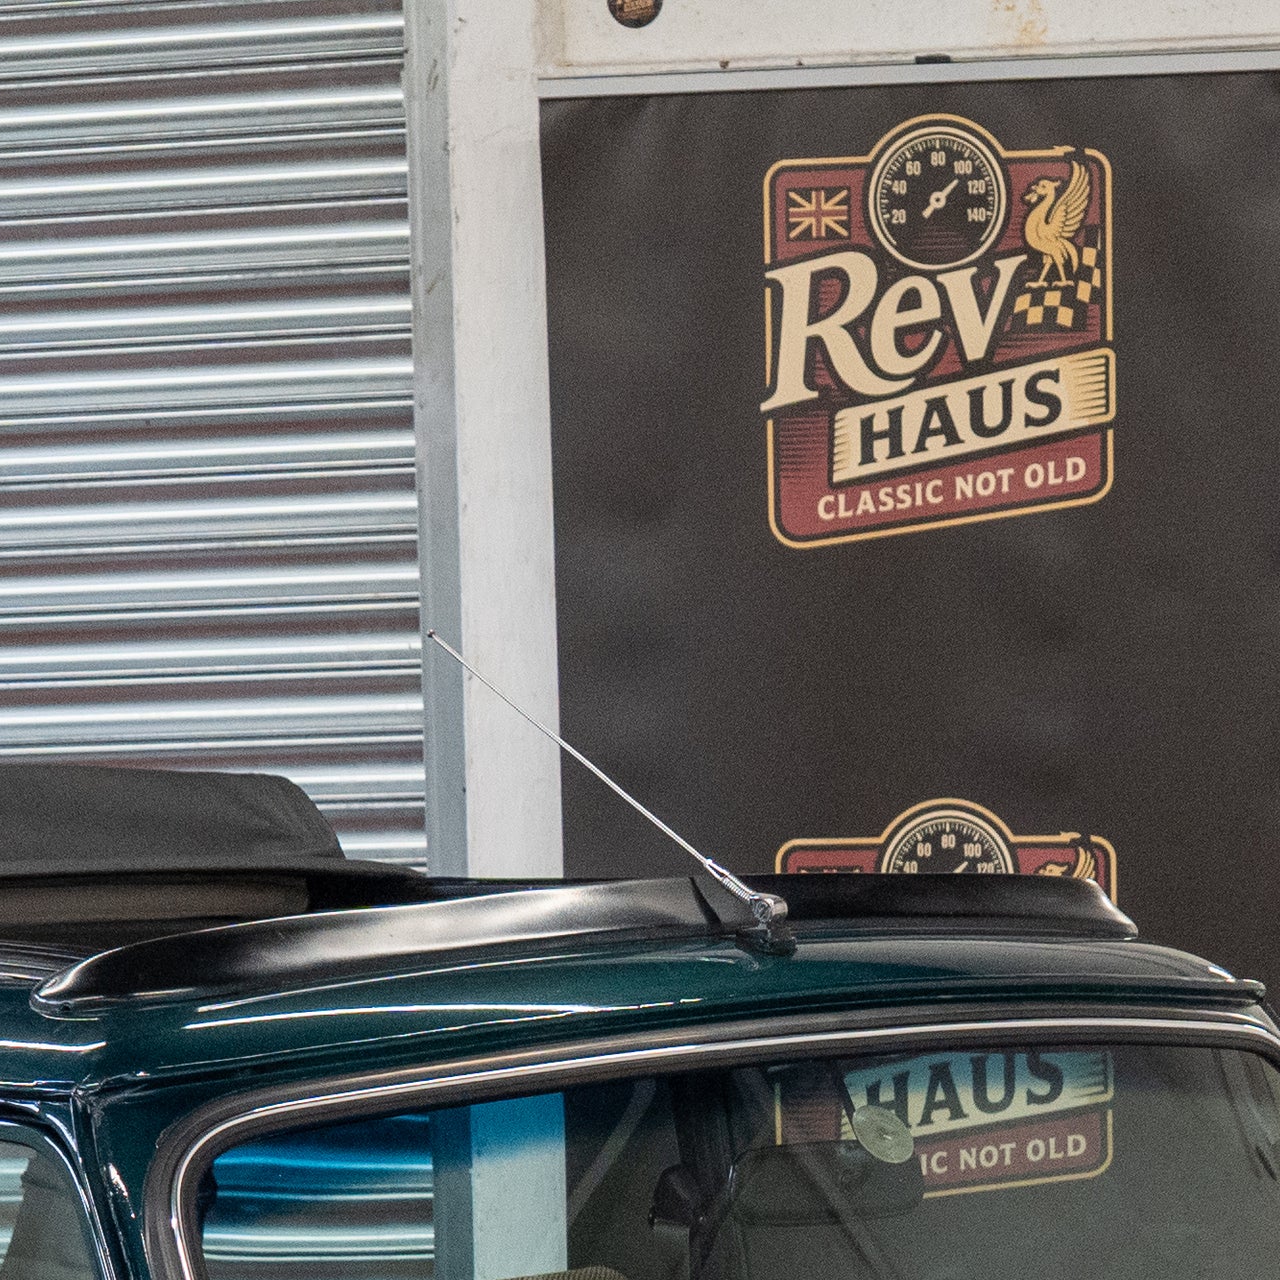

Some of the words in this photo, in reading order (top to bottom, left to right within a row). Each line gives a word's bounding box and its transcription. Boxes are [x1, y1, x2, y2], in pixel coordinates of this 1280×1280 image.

[931, 151, 946, 166] 80
[906, 161, 921, 175] 60
[954, 160, 972, 175] 100
[892, 180, 907, 195] 40
[967, 180, 985, 194] 120
[891, 209, 906, 223] 20
[967, 207, 986, 221] 140
[760, 250, 1028, 413] Rev
[858, 368, 1062, 465] HAUS
[817, 478, 944, 520] CLASSIC
[955, 467, 1014, 500] NOT
[1024, 456, 1086, 489] OLD
[941, 834, 956, 849] 80
[963, 843, 982, 858] 100
[865, 1052, 1064, 1128] HAUS
[959, 1142, 1016, 1170] NOT
[1026, 1134, 1087, 1162] OLD
